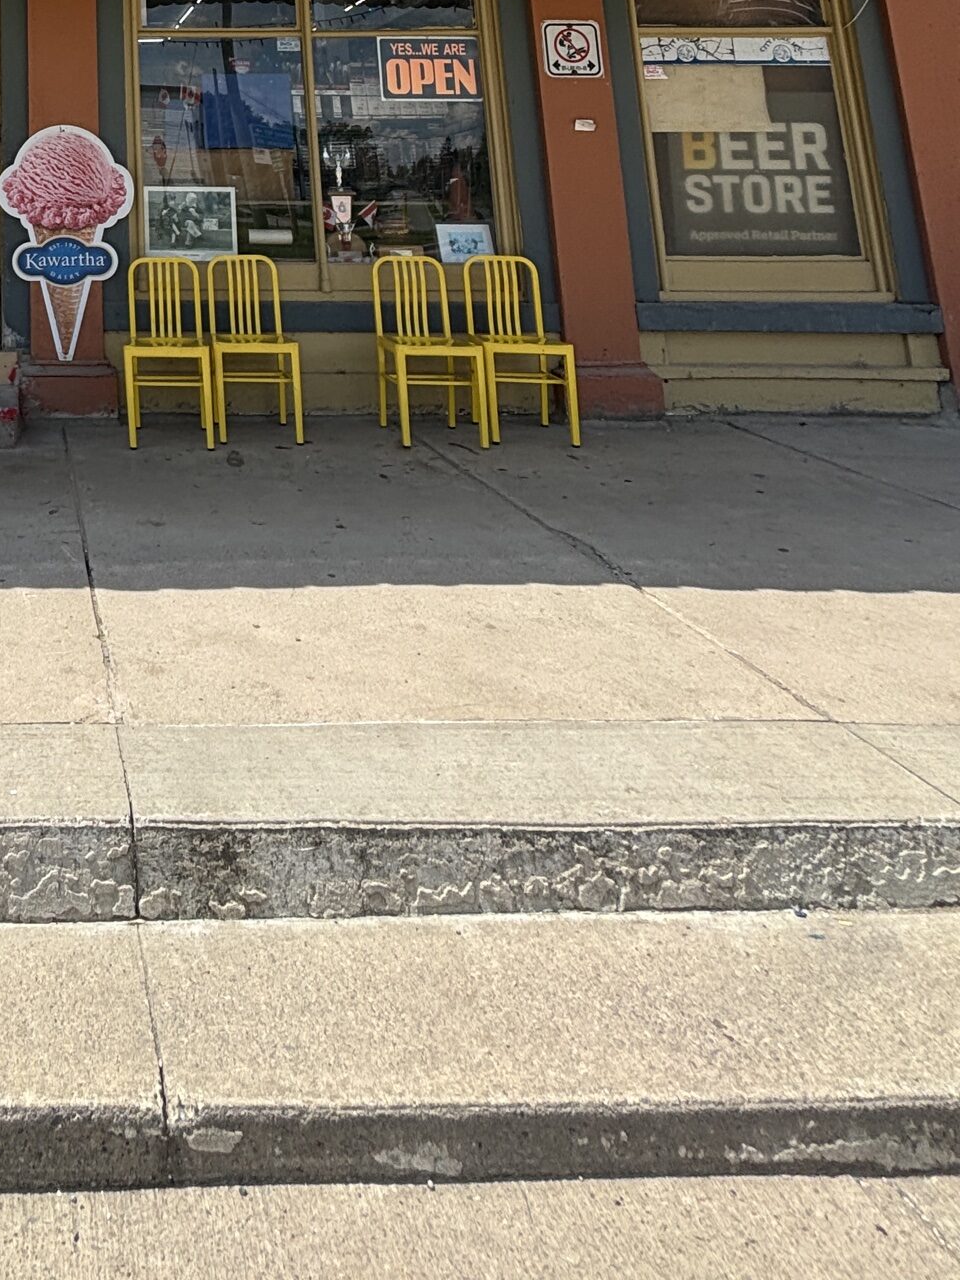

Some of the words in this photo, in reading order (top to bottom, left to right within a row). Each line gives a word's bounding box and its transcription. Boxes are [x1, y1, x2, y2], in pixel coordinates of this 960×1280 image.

[443, 43, 467, 56] ARE
[385, 58, 478, 96] OPEN
[682, 122, 830, 170] BEER
[685, 174, 835, 214] STORE
[691, 230, 750, 241] Approved
[751, 230, 789, 241] Retail
[791, 230, 838, 241] Partner
[25, 252, 105, 270] Kawartha
[49, 271, 80, 280] DAIRY
